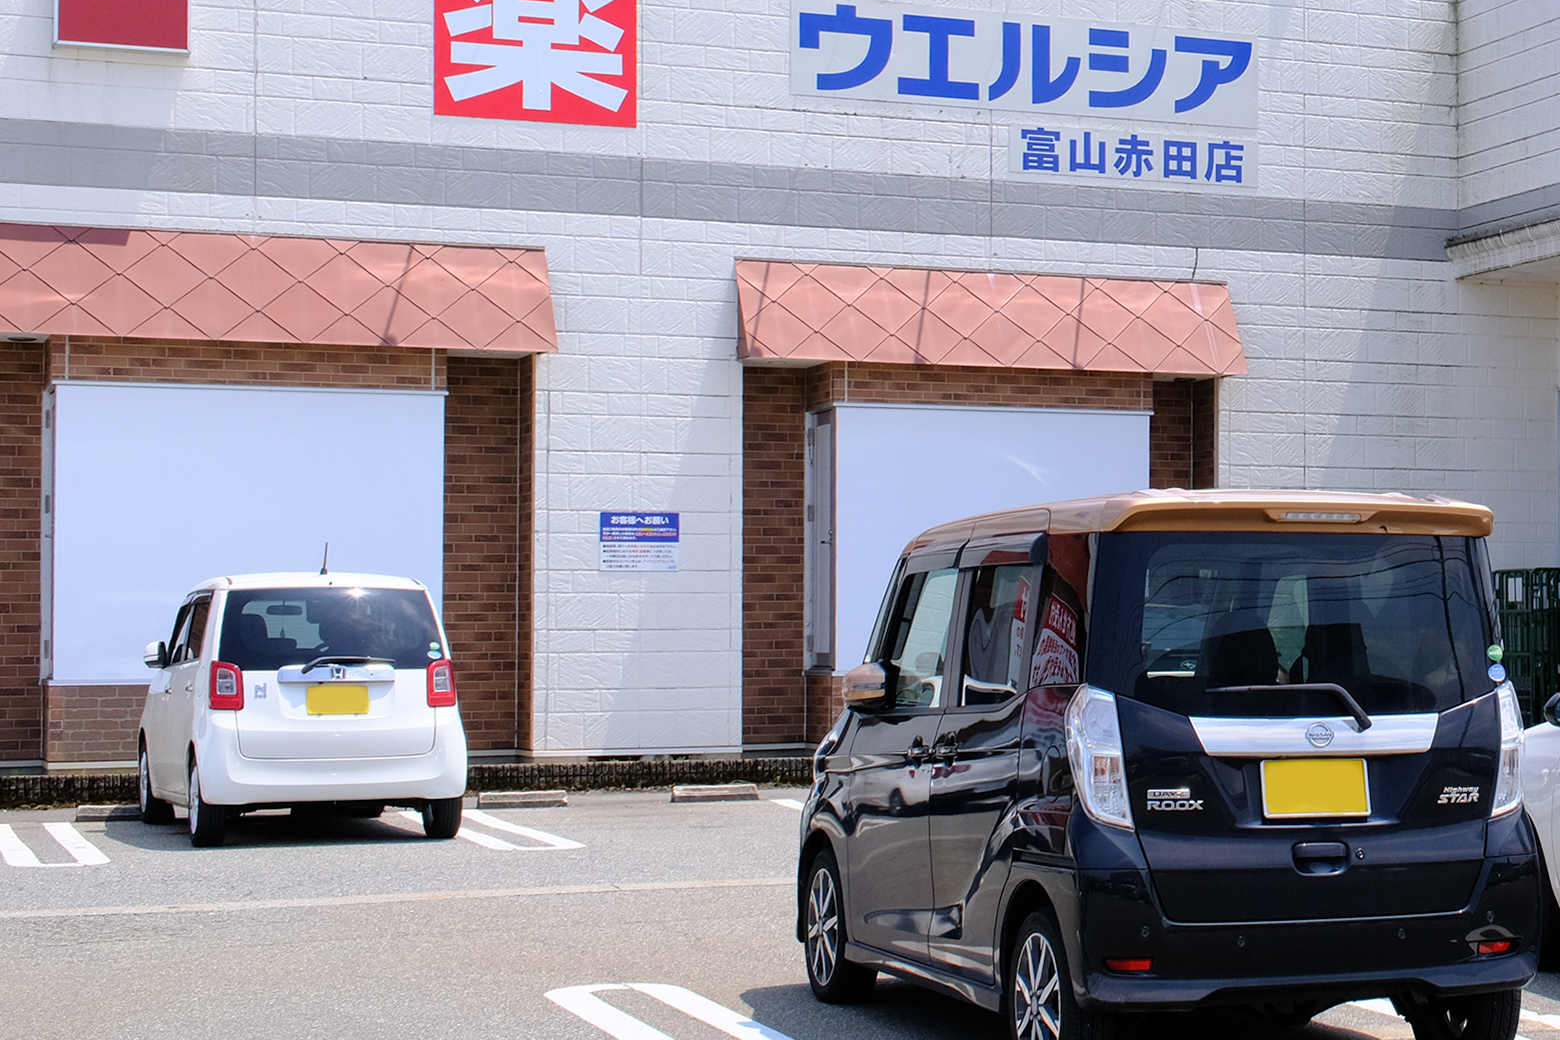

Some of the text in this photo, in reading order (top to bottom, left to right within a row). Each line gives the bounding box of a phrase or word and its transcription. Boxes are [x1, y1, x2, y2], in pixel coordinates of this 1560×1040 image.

[798, 3, 1253, 115] ウエルシア
[1019, 126, 1245, 185] 富山赤田店
[1309, 731, 1333, 739] NISSAN
[1443, 786, 1480, 795] Highway
[1437, 793, 1480, 805] STAR
[1147, 800, 1204, 811] ROOX
